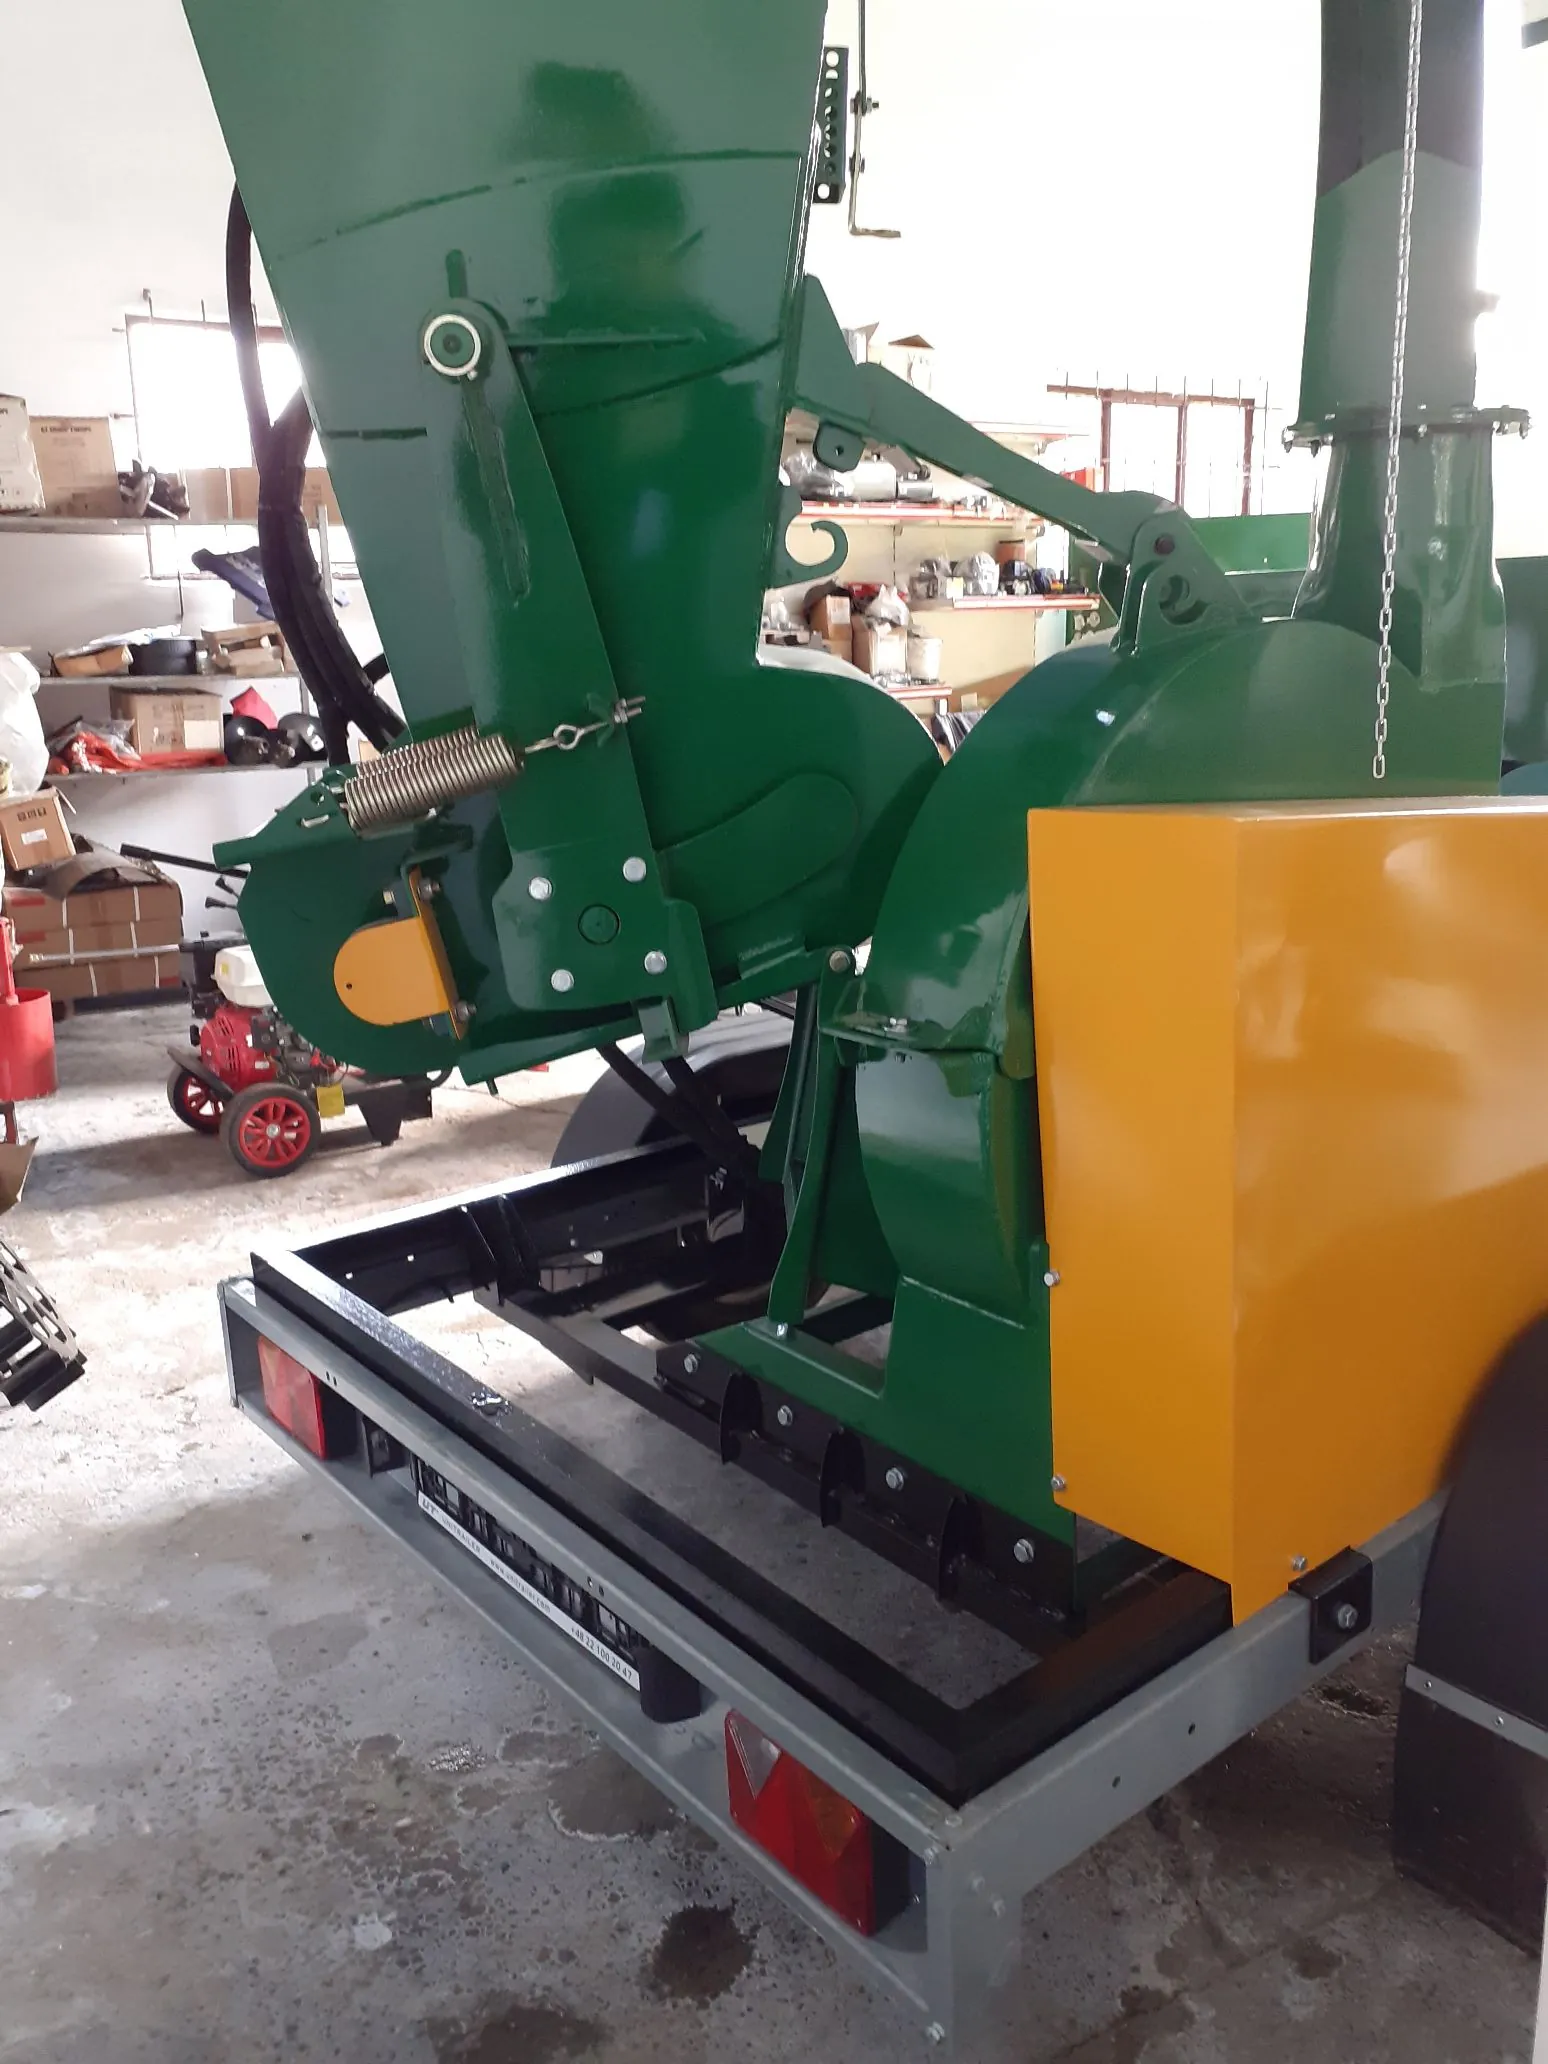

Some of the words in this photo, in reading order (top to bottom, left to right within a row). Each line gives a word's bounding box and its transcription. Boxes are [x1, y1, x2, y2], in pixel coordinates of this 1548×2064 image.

[441, 1515, 481, 1553] UNITRAILER
[490, 1559, 551, 1613] www.unitrailer.com
[571, 1627, 584, 1641] +48
[586, 1636, 595, 1649] 22
[597, 1646, 610, 1662] 100
[612, 1657, 621, 1671] 20
[623, 1667, 632, 1680] 47
